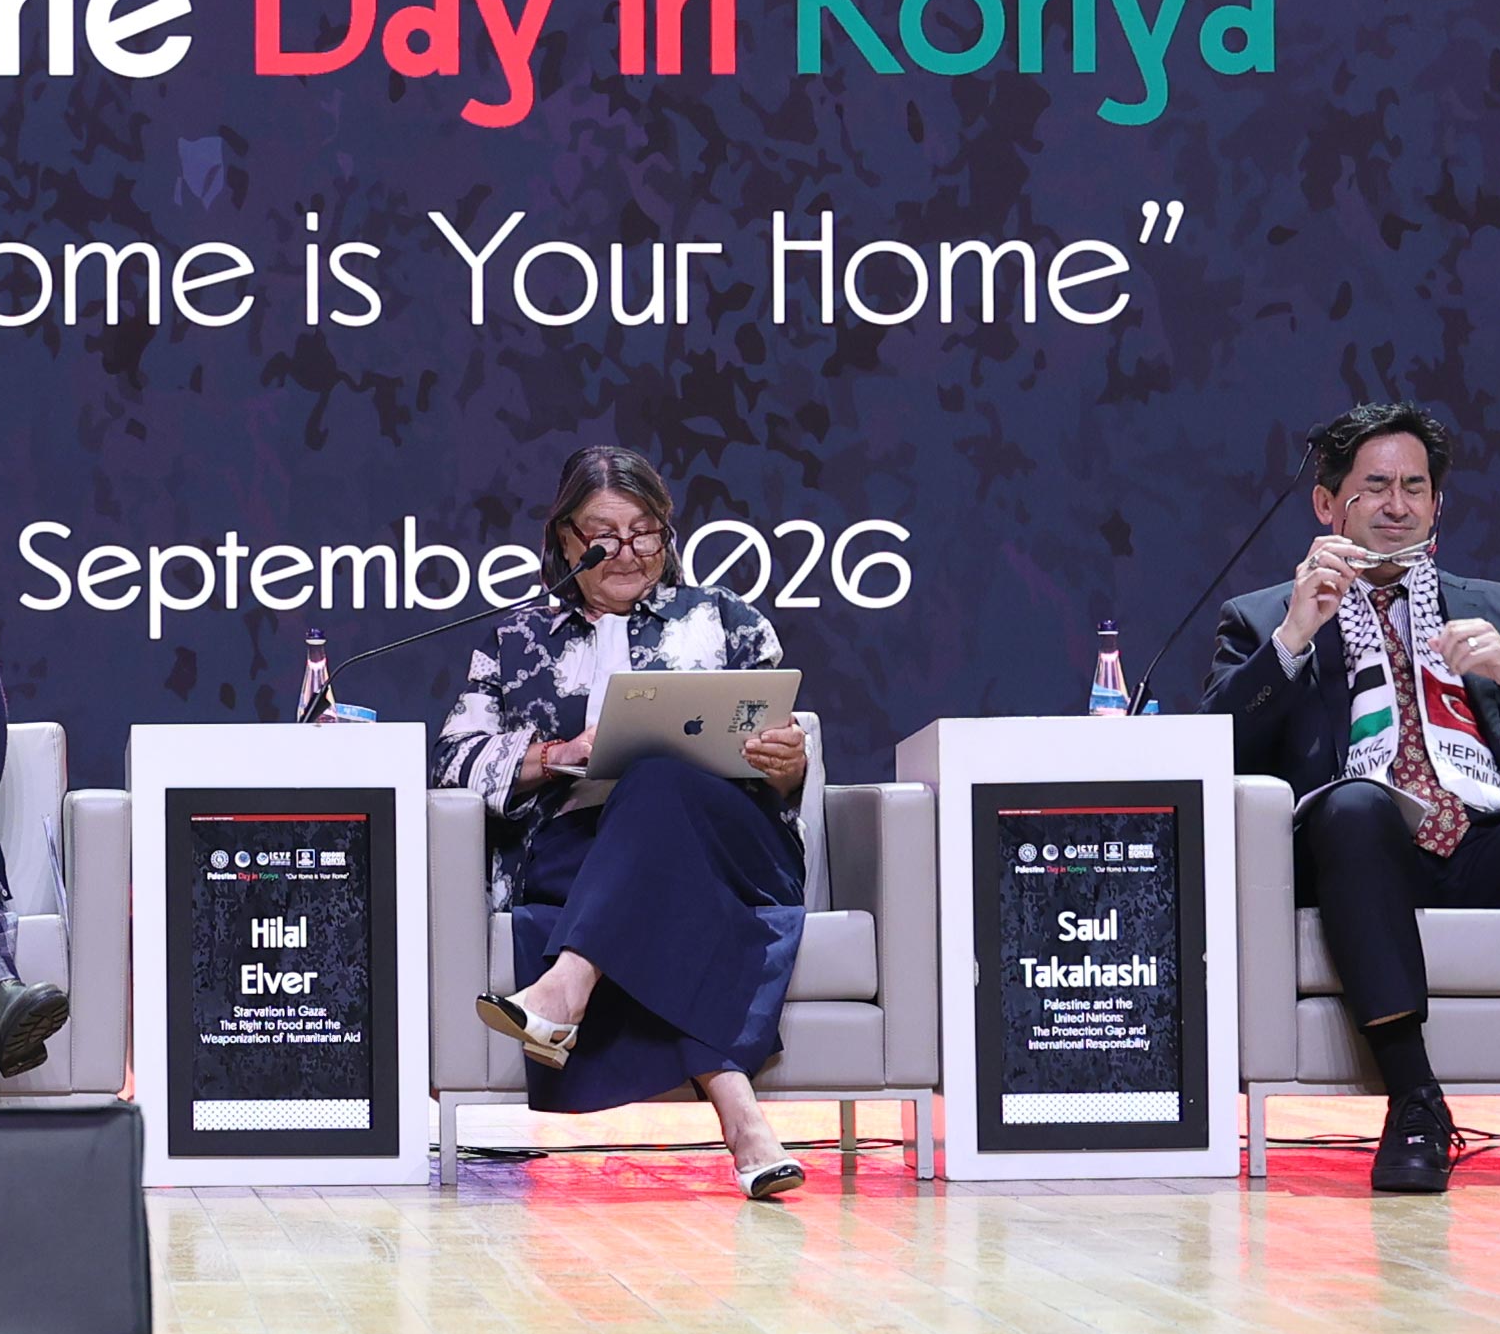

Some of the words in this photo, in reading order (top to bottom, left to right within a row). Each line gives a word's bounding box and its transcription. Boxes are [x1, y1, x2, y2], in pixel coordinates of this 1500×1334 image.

[306, 211, 382, 327] is
[427, 211, 723, 326] Your
[19, 520, 561, 640] Septembe
[682, 520, 912, 609] 026
[251, 916, 307, 948] Hilal
[1057, 909, 1118, 942] Saul
[241, 964, 318, 995] Elver
[1020, 956, 1157, 989] Takahashi
[1044, 998, 1091, 1010] Palestine
[1093, 998, 1113, 1010] and
[1115, 997, 1133, 1009] the
[233, 1006, 285, 1017] Starvation
[287, 1006, 296, 1017] in
[298, 1005, 327, 1017] Gaza:
[1054, 1012, 1084, 1023] United
[1086, 1012, 1124, 1023] Nations:
[220, 1020, 237, 1031] The
[239, 1020, 262, 1033] Right
[264, 1021, 275, 1030] to
[277, 1019, 303, 1031] Food
[305, 1019, 323, 1030] and
[324, 1019, 341, 1030] the
[1033, 1026, 1050, 1036] The
[1052, 1025, 1103, 1036] Protection
[1105, 1025, 1126, 1038] Gap
[1128, 1024, 1146, 1035] and
[200, 1033, 271, 1046] Weaponization
[272, 1032, 285, 1044] of
[287, 1032, 341, 1043] Humanitarian
[343, 1032, 361, 1043] Aid
[1028, 1039, 1084, 1050] International
[1086, 1038, 1151, 1051] Responsibility
